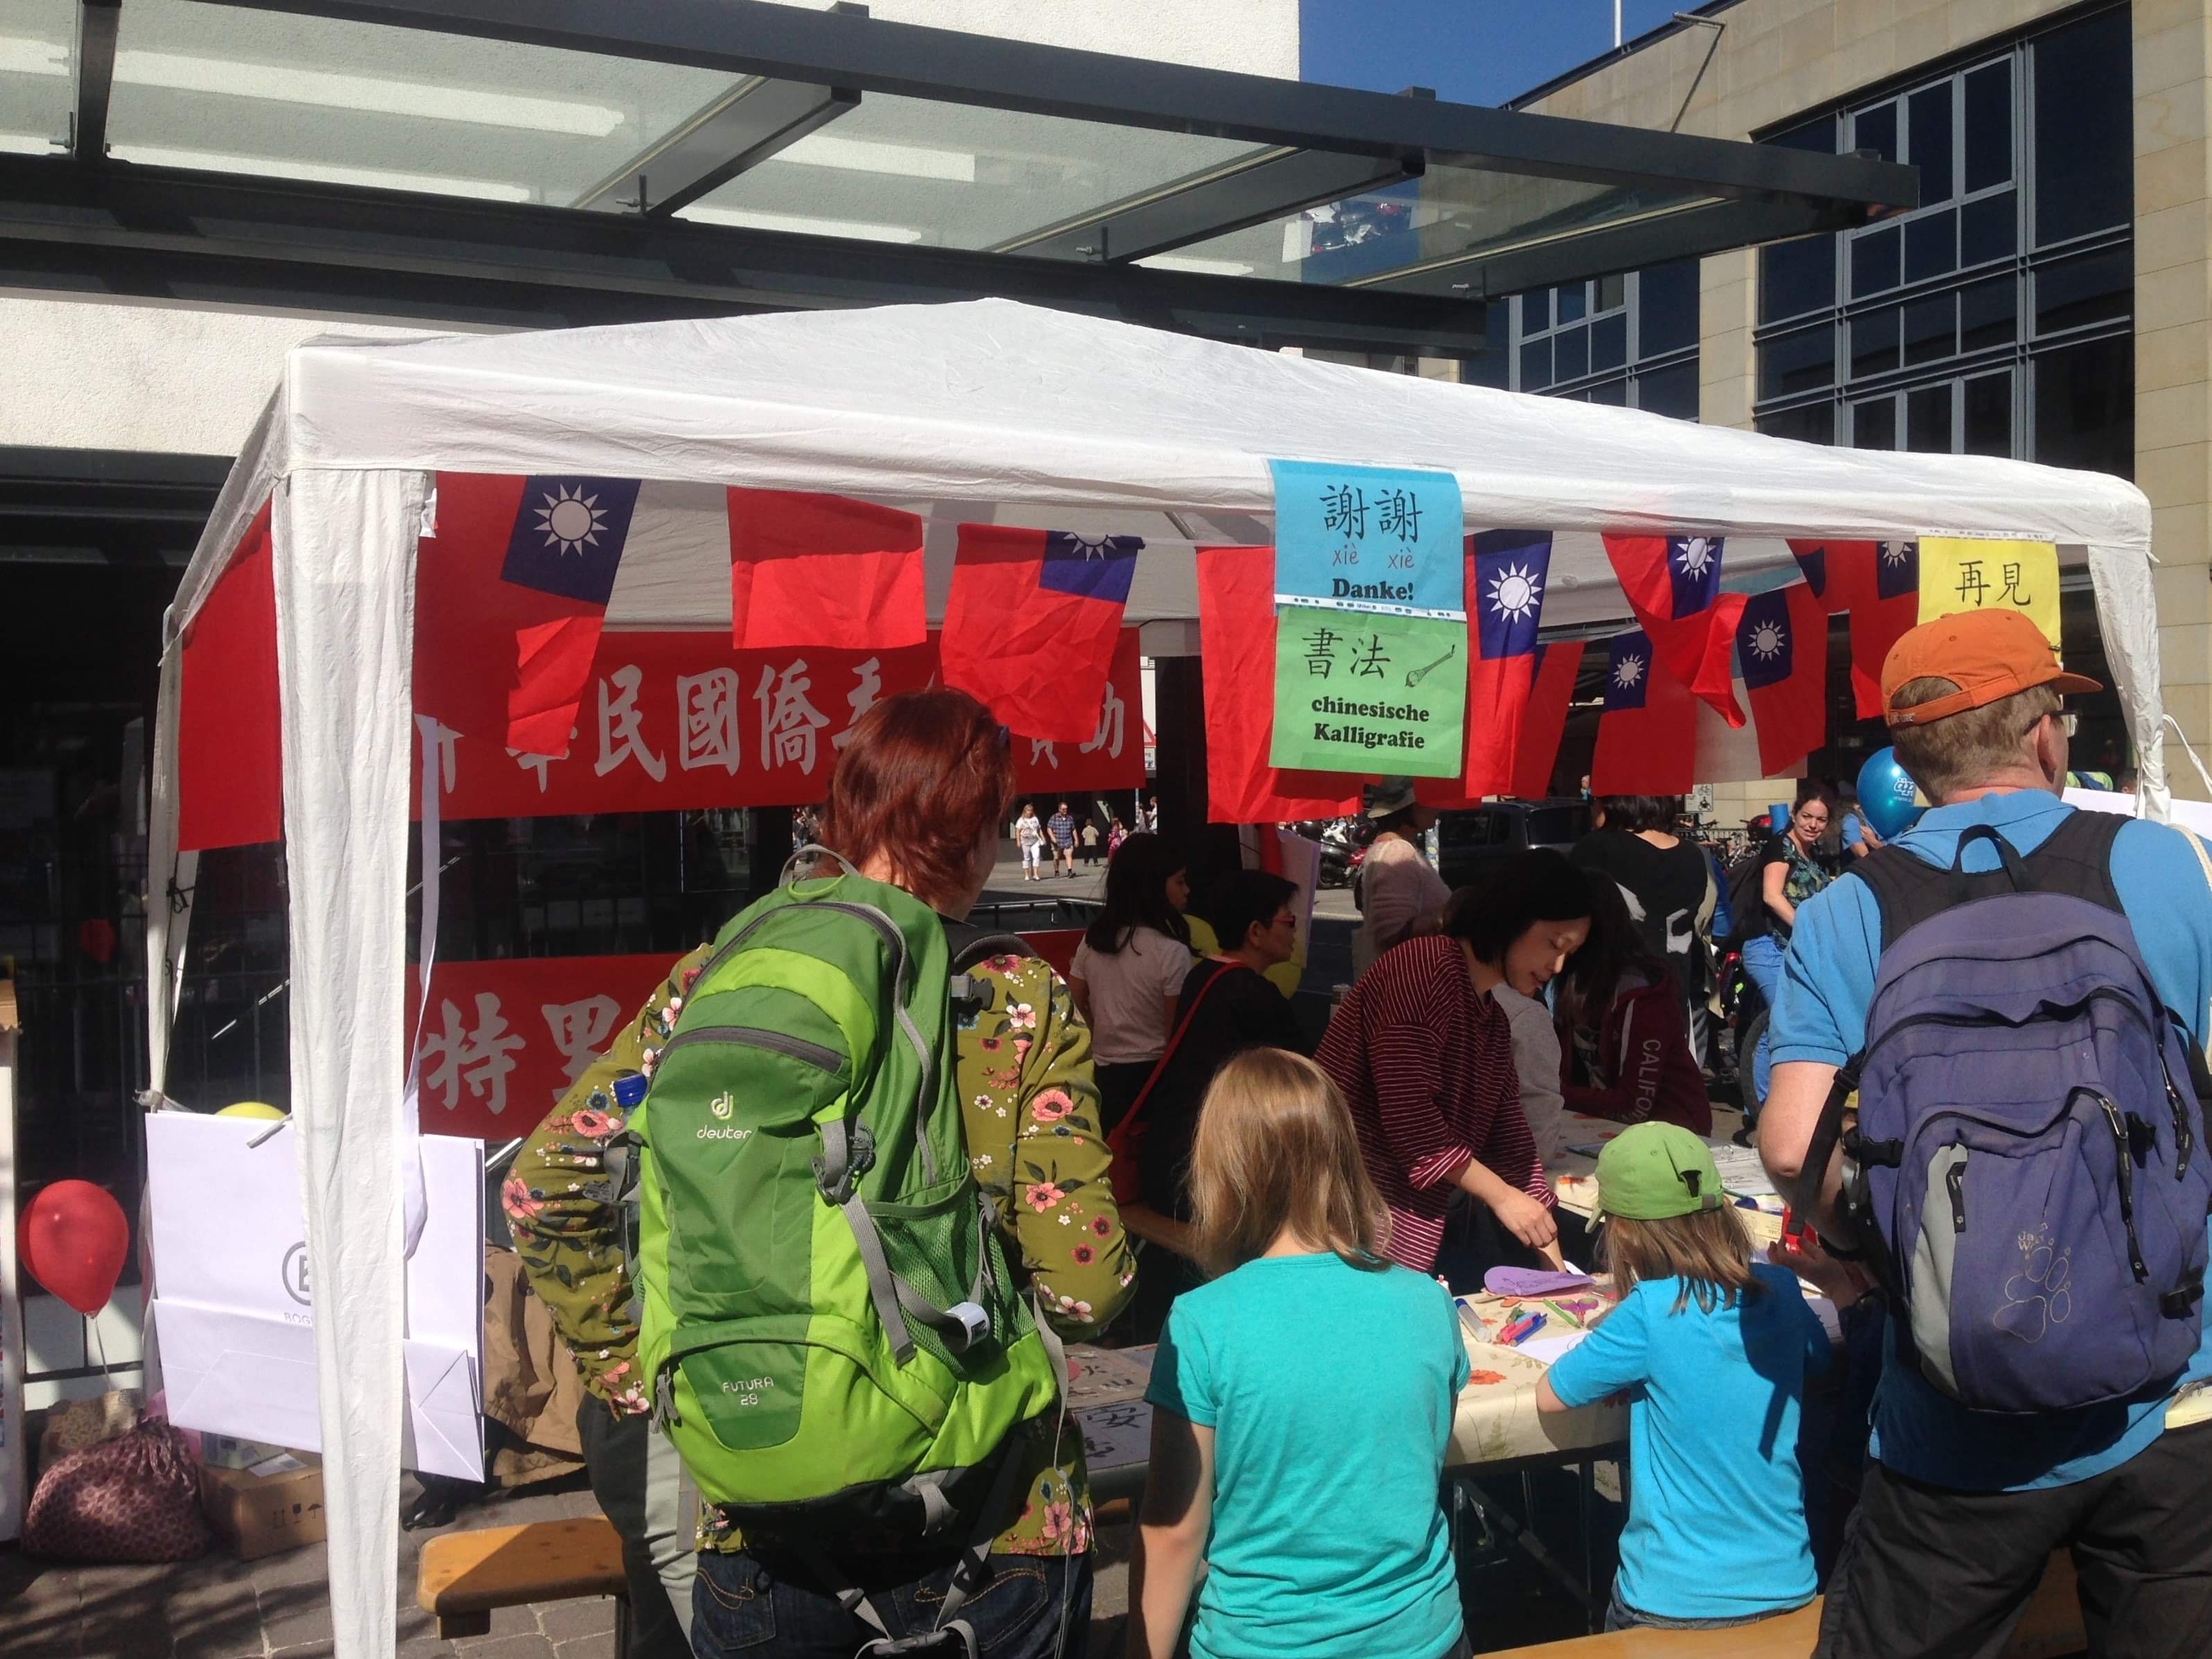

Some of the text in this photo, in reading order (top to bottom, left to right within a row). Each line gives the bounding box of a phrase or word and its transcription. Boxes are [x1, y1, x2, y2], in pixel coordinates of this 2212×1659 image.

[1320, 484, 1423, 543] 謝謝
[1332, 543, 1415, 570] xiè xiè
[1332, 578, 1414, 601] Danke!
[1955, 559, 2031, 607] 再見
[1302, 627, 1391, 679] 書法
[1311, 695, 1429, 722] chinesische
[1314, 722, 1425, 749] Kalligrafie
[697, 1124, 752, 1139] deuter
[722, 1376, 774, 1393] FUTURA
[740, 1393, 758, 1406] 28
